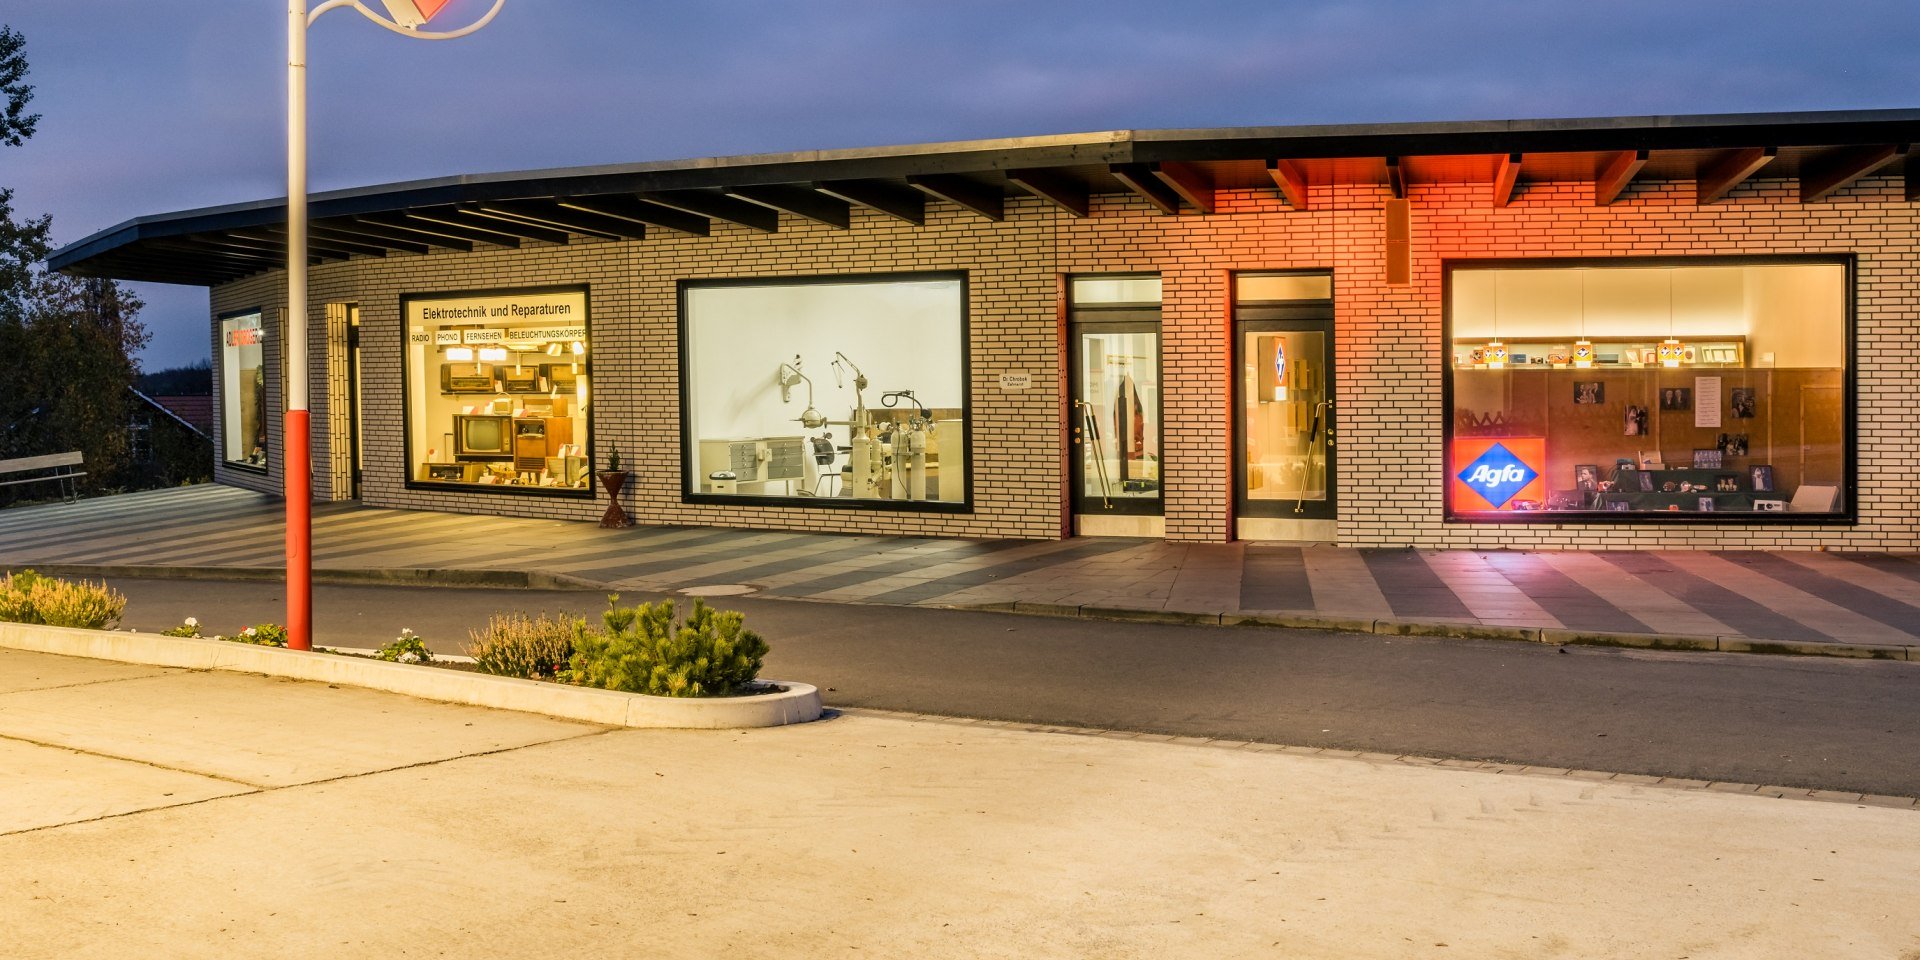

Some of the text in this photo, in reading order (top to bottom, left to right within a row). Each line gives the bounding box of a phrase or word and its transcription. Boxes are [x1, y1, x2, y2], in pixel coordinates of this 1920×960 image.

[423, 303, 571, 319] Elektrotechnik und Reparaturen
[411, 334, 430, 342] RADIO
[437, 333, 458, 341] PHONO
[466, 332, 502, 340] FERNSEHEN
[1467, 464, 1525, 488] Agfa
